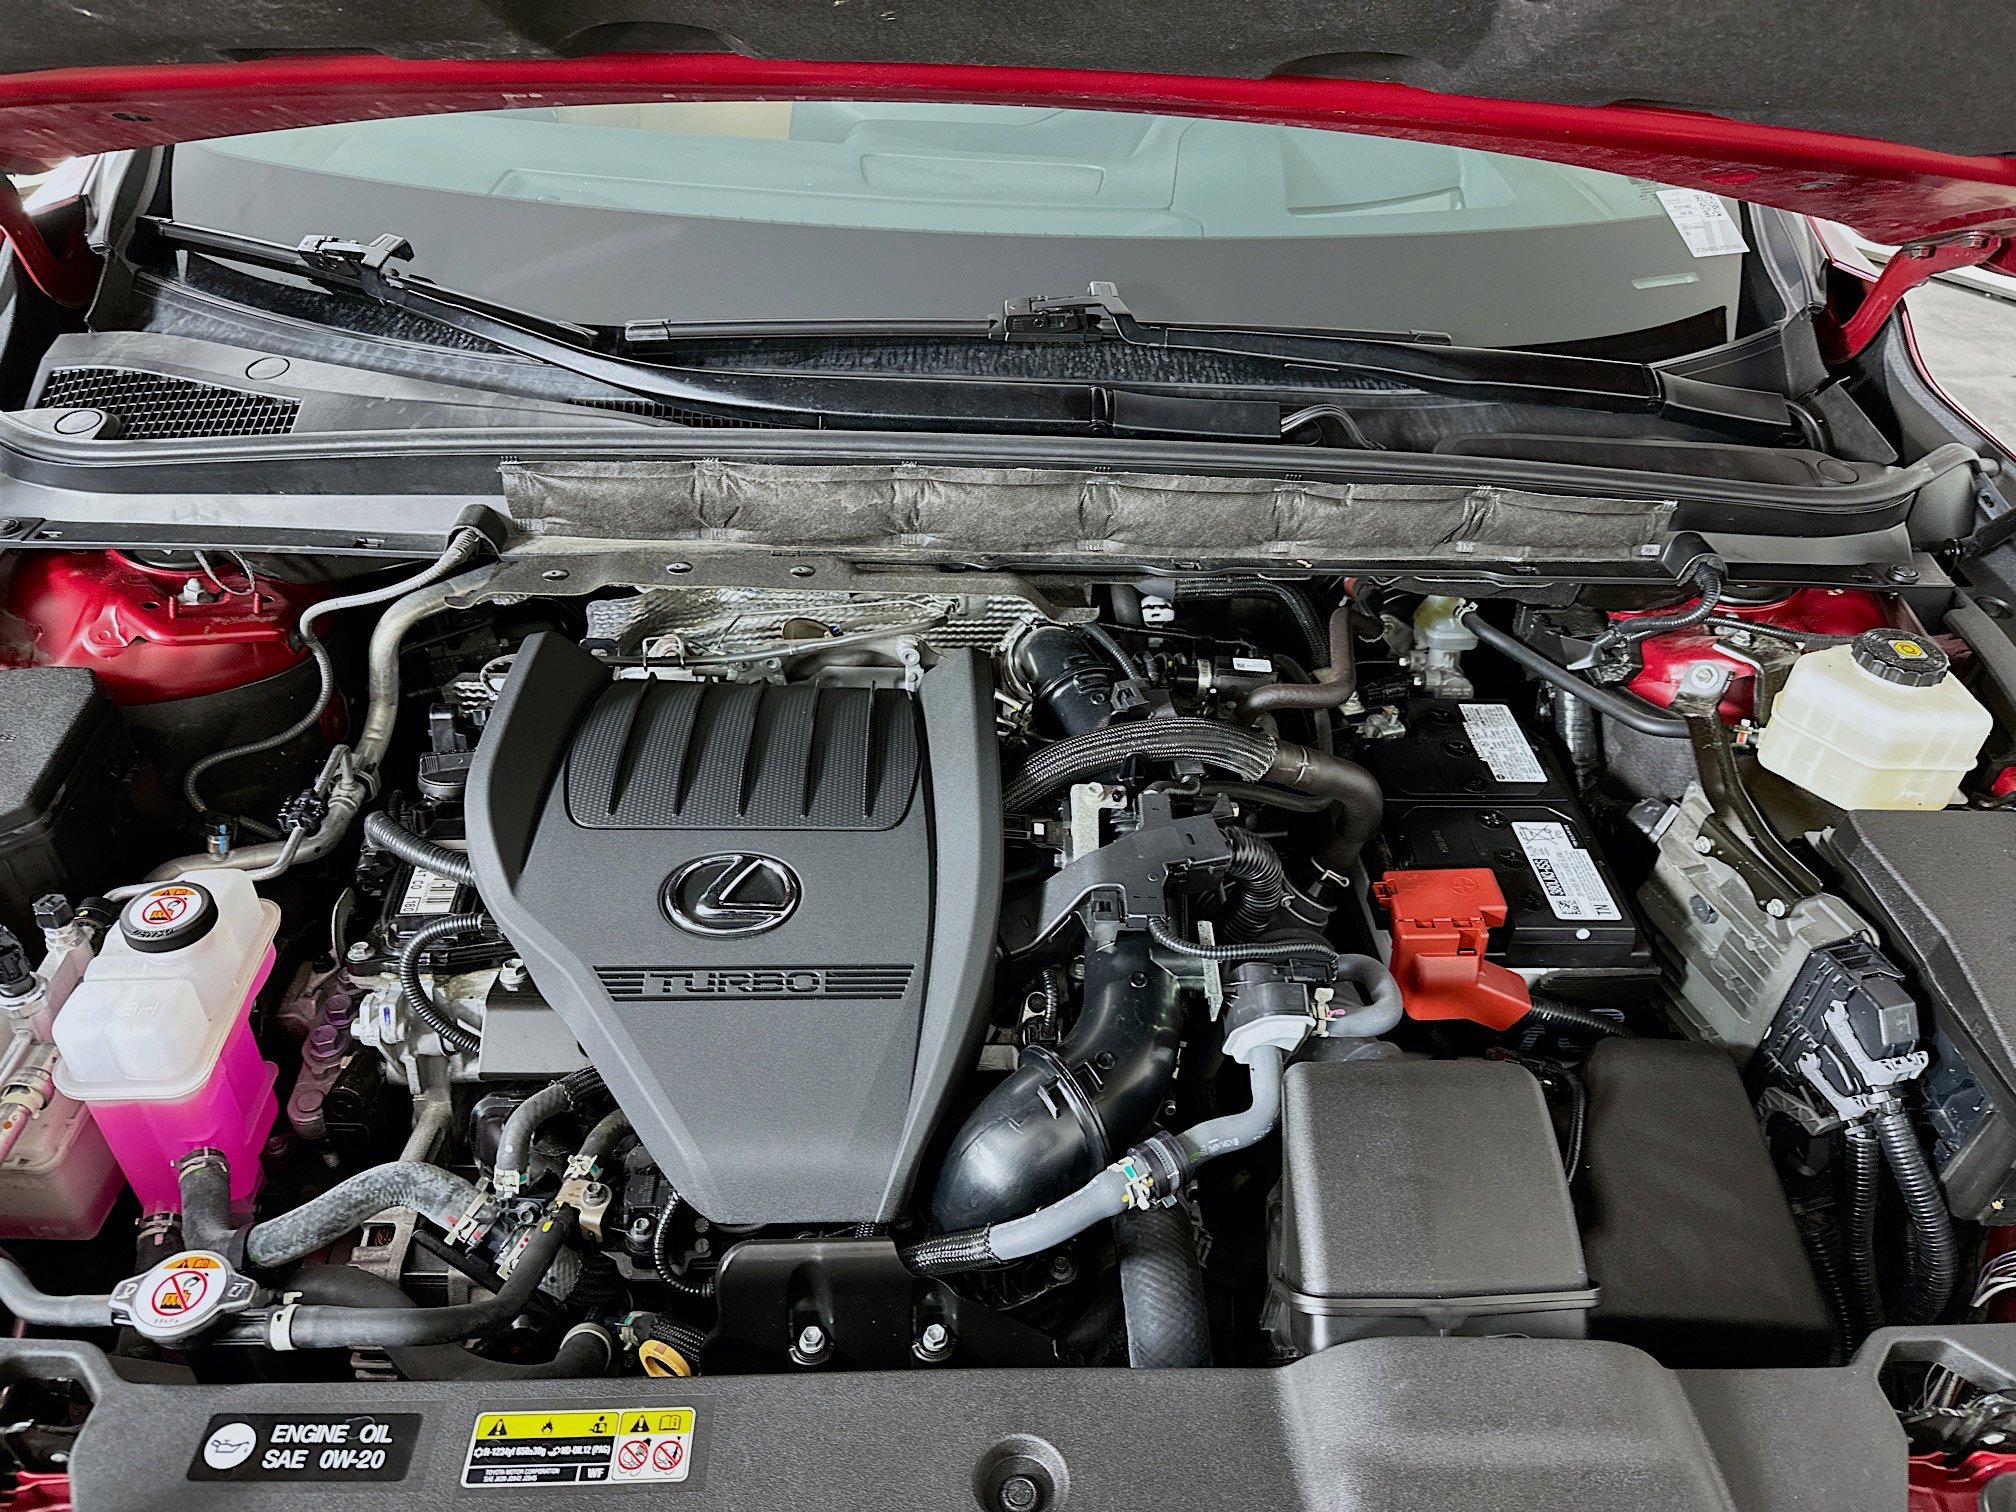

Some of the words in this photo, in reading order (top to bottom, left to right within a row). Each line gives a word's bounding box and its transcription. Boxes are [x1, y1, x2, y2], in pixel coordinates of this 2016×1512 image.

[1593, 904, 1613, 915] TN
[650, 970, 822, 993] TURBO
[270, 1424, 350, 1444] ENGINE
[359, 1424, 393, 1444] OIL
[261, 1449, 309, 1469] SAE
[319, 1449, 386, 1469] 0W-20
[588, 1468, 605, 1478] WF
